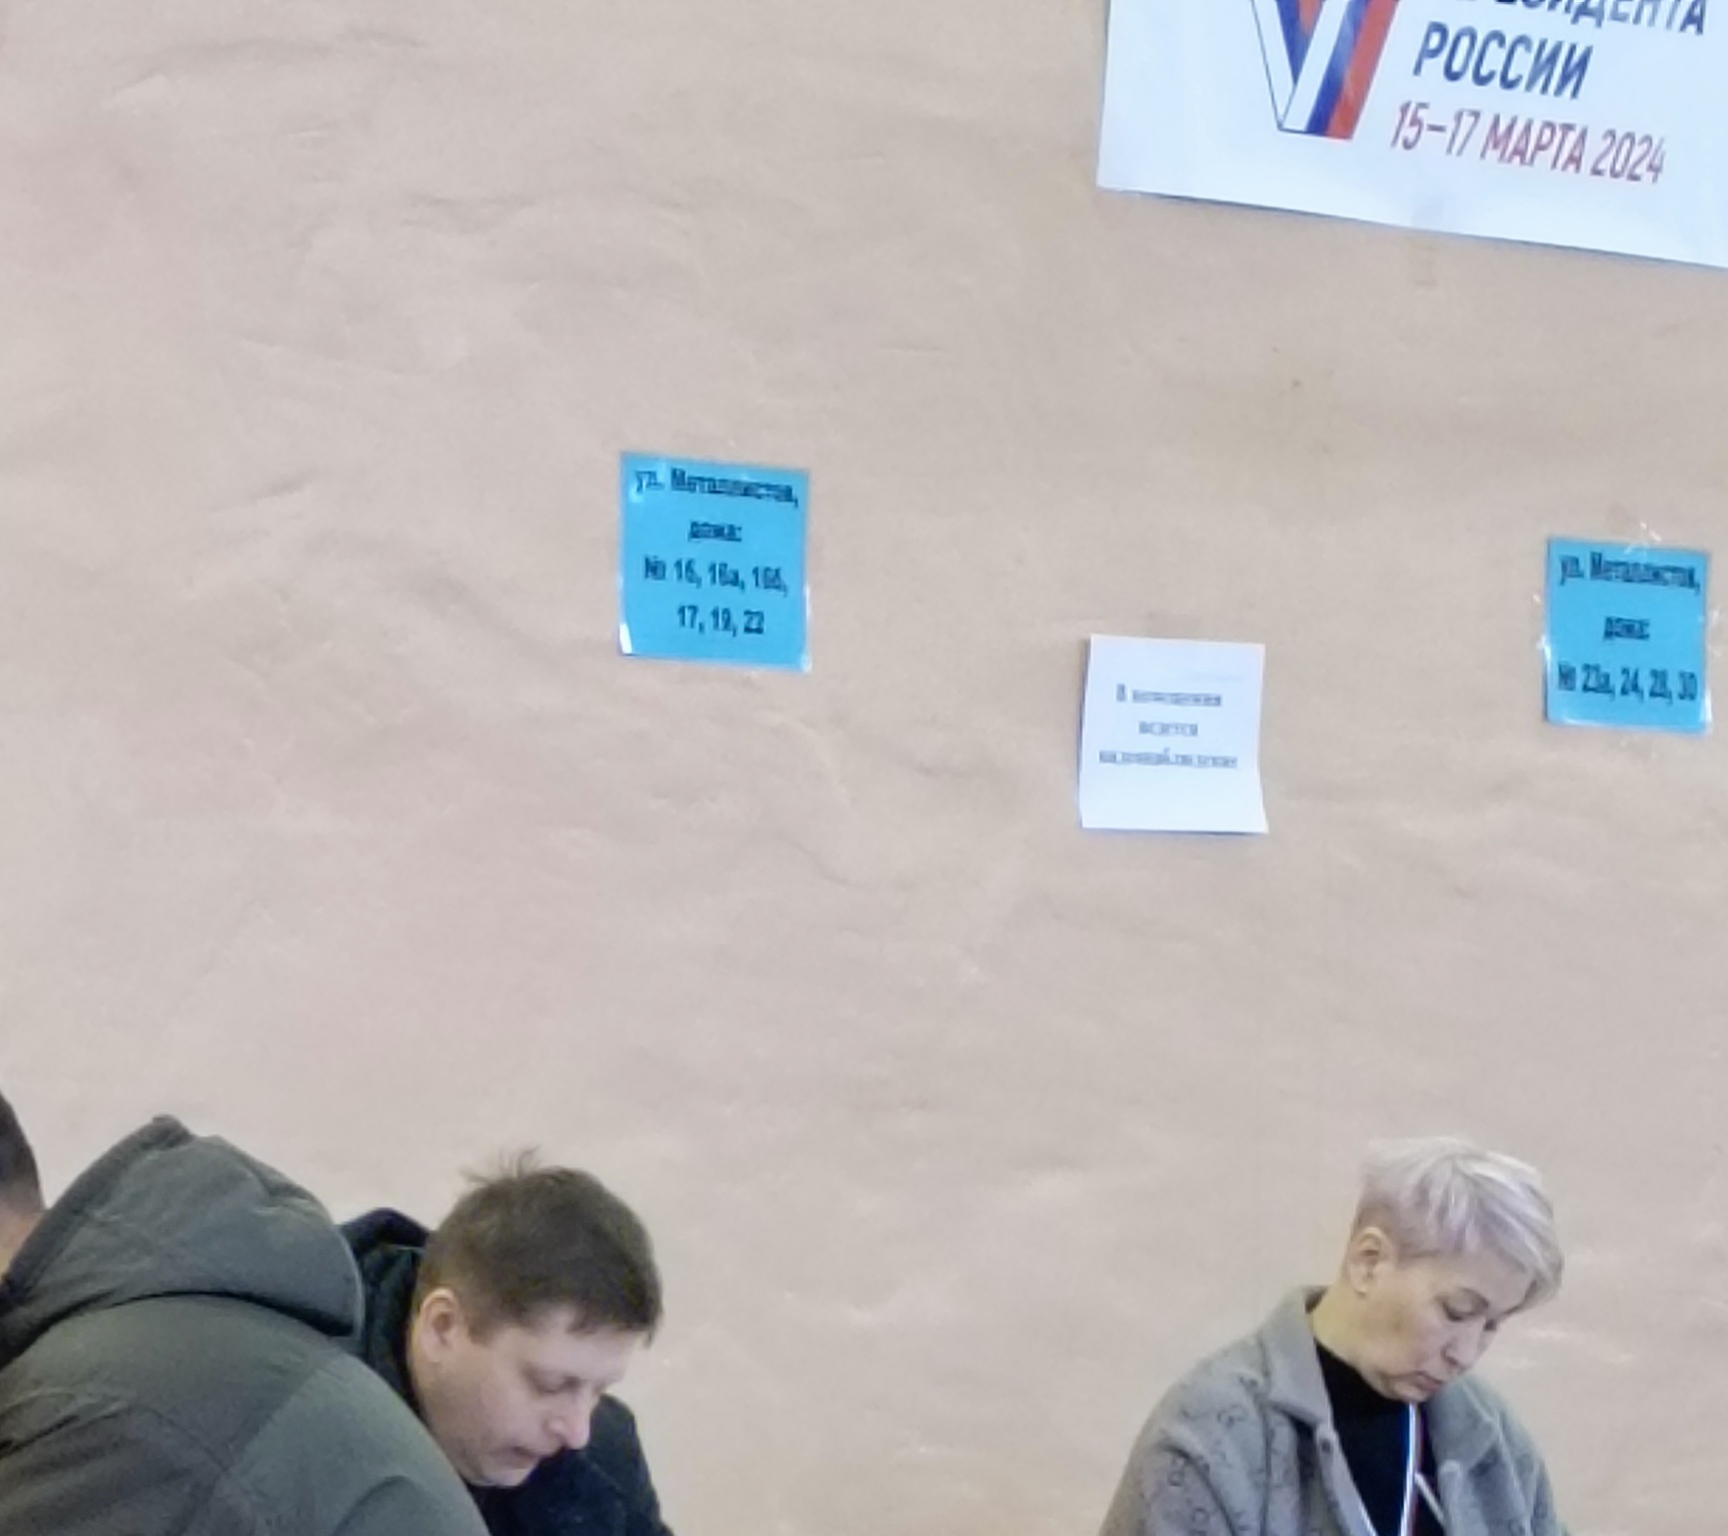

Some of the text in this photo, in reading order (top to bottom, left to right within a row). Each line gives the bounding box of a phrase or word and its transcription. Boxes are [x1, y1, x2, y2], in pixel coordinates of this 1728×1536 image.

[1413, 20, 1593, 100] РОССИИ
[1480, 113, 1589, 174] МАРТА
[1589, 128, 1666, 184] 2024
[677, 604, 705, 634] 17,
[743, 610, 765, 634] 22
